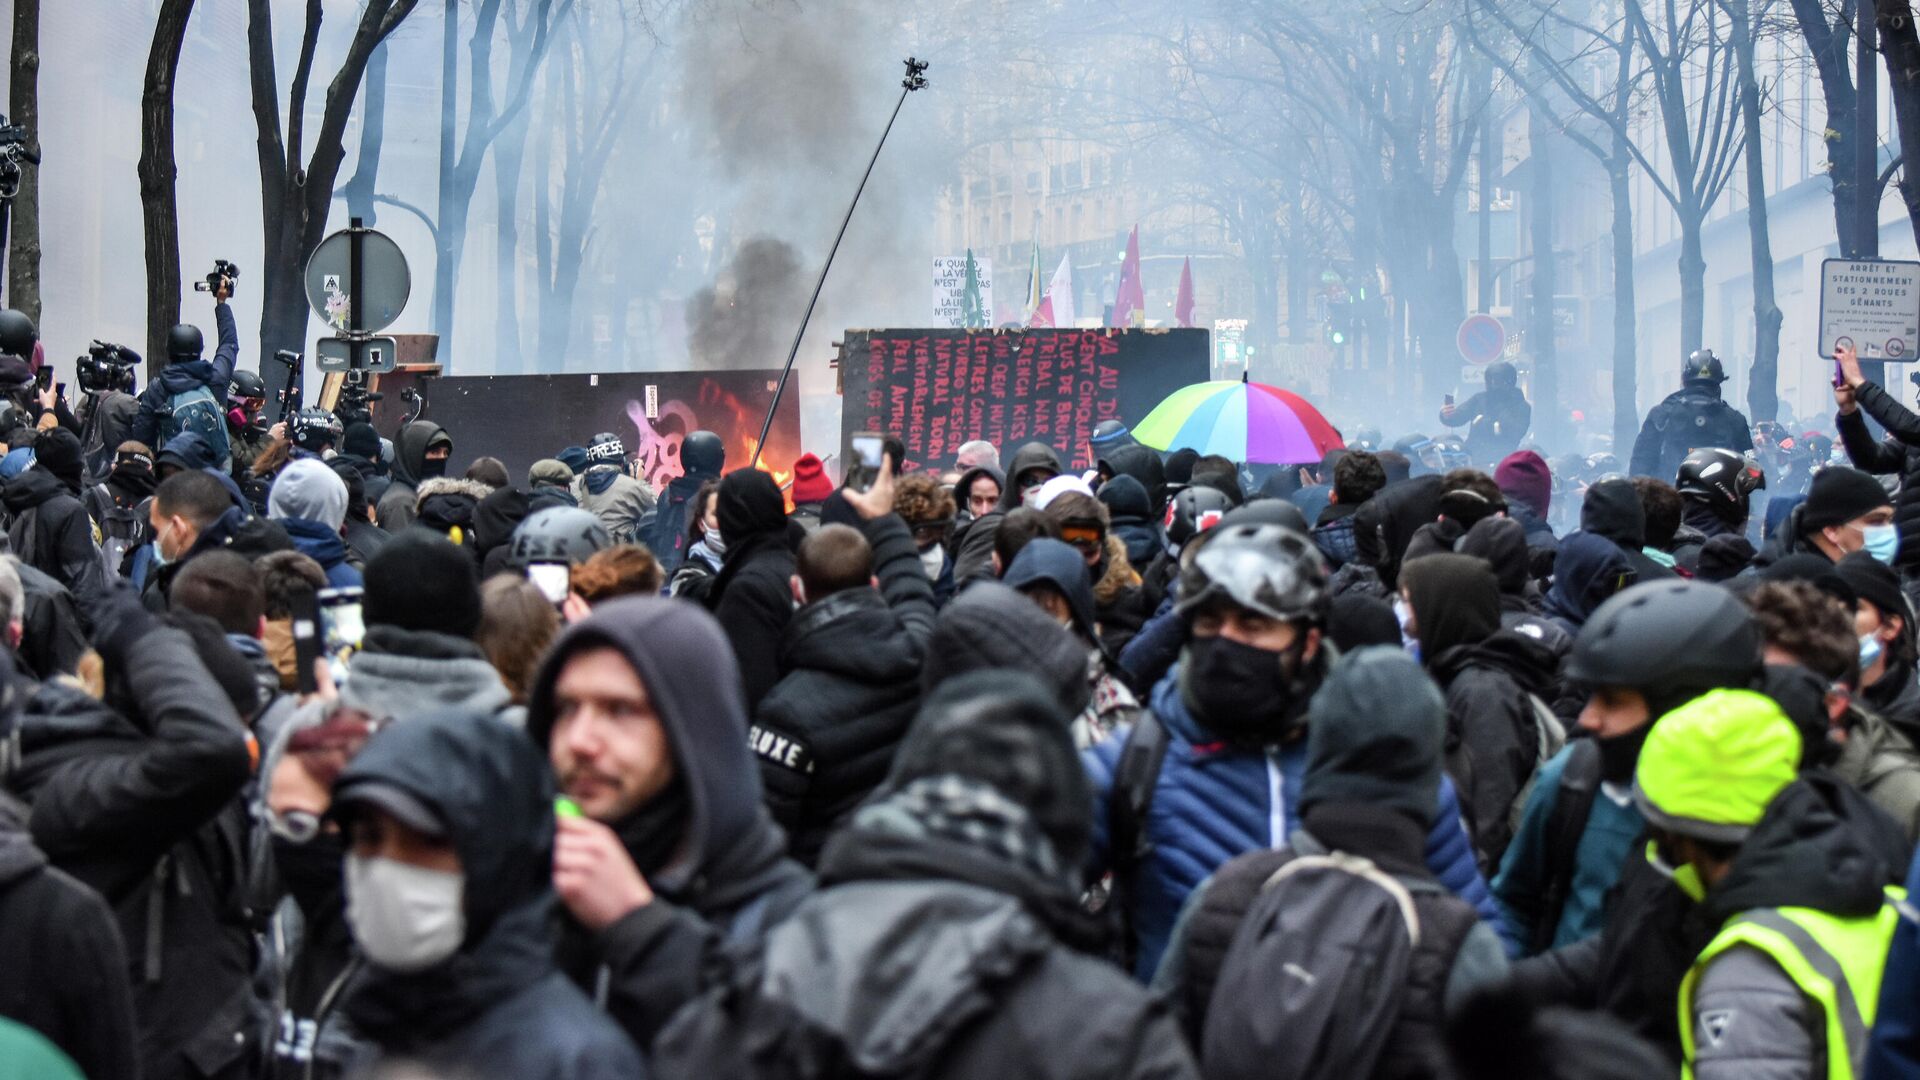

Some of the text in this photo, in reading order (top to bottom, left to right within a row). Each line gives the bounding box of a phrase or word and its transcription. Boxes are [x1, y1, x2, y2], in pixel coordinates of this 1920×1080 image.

[943, 269, 953, 277] LA
[947, 260, 978, 269] QUAD
[1850, 264, 1896, 273] ARRÊT ET
[934, 279, 957, 287] N'EST
[1833, 275, 1913, 285] STATIONNEMENT
[1837, 287, 1907, 296] DES 2 ROUES
[1850, 297, 1893, 307] GÊNANTS
[934, 308, 958, 316] N'EST
[941, 299, 951, 307] LA
[891, 339, 911, 375] REAL
[992, 336, 1009, 358] UN
[1060, 333, 1079, 370] PLUS
[1080, 331, 1098, 375] CENT
[1014, 337, 1037, 397] FRENCH
[1098, 366, 1119, 389] AU
[967, 337, 991, 443] LETTRES CONTR
[990, 364, 1008, 399] OEUF
[1058, 374, 1075, 395] DE
[866, 389, 883, 408] OF
[1032, 400, 1051, 436] WAR
[927, 416, 947, 460] BORN
[590, 440, 624, 461] PRESS
